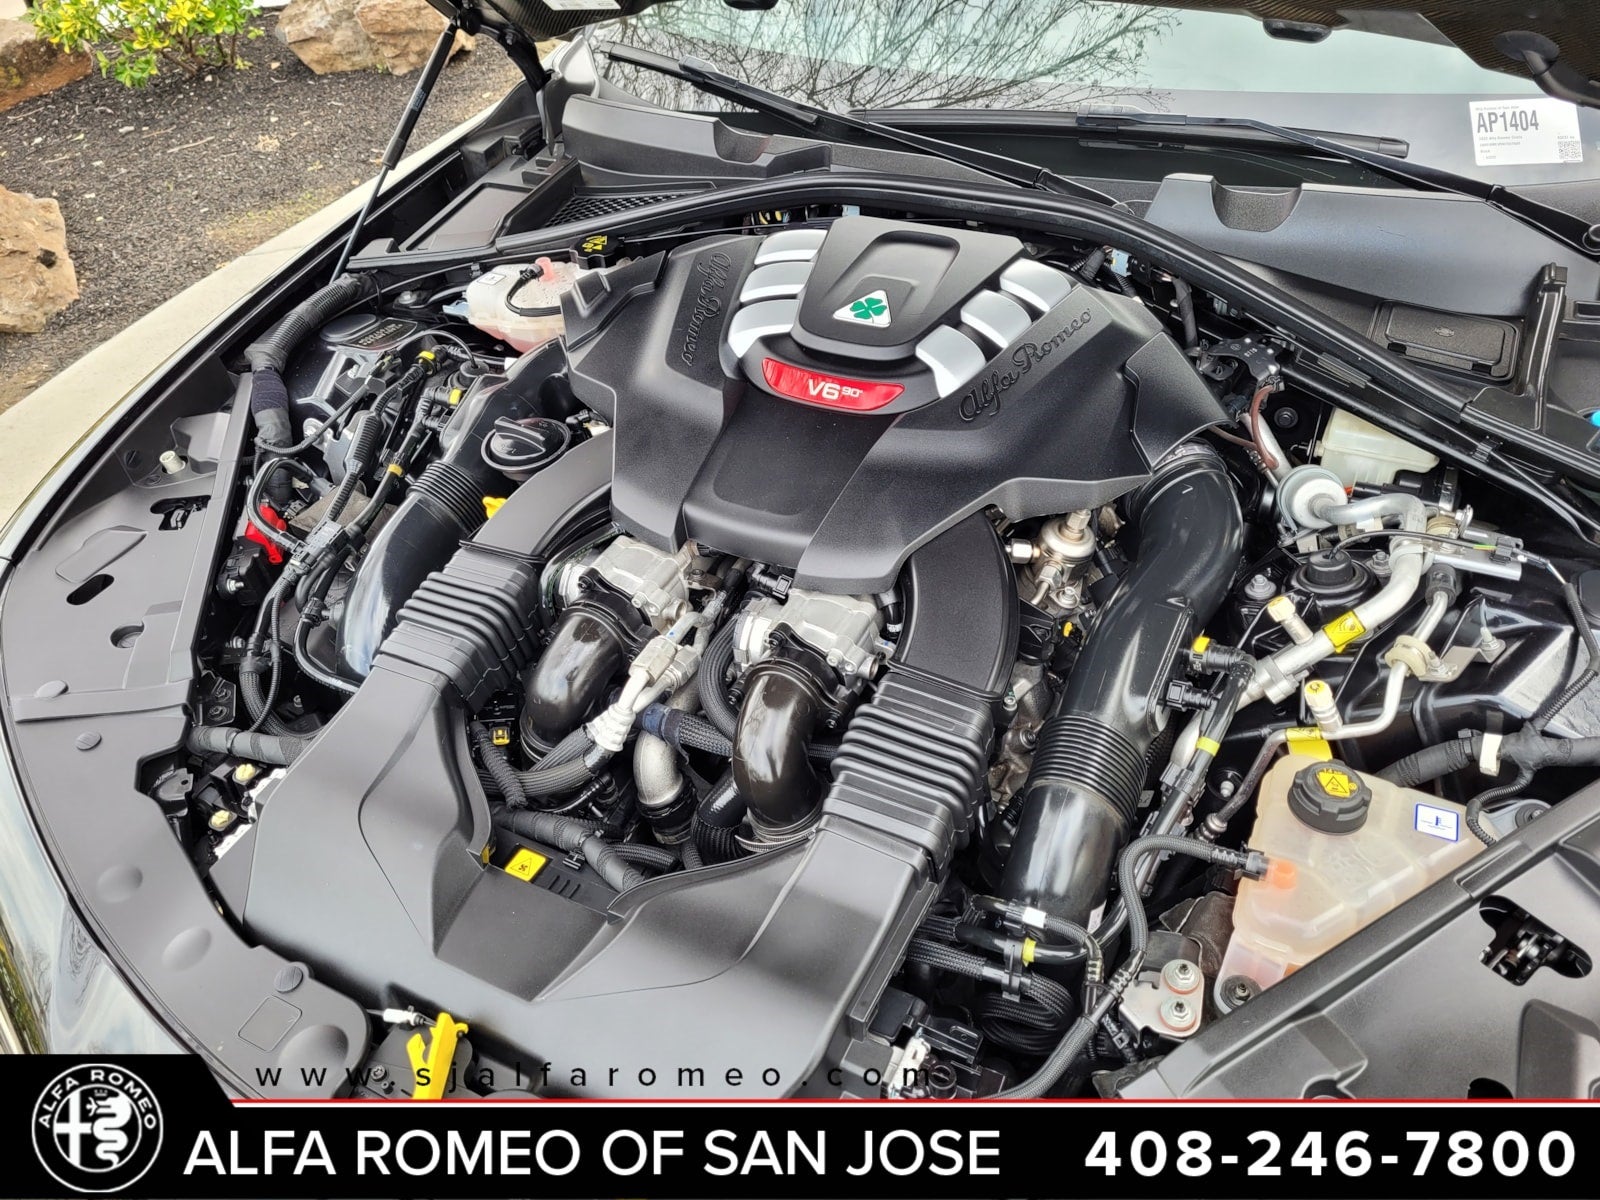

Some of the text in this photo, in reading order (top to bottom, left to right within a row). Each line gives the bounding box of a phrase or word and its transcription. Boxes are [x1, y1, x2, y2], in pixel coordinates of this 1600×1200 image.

[1477, 110, 1539, 133] AP1404
[682, 251, 732, 367] Alfa Romeo
[959, 308, 1093, 422] Alfa Romeo
